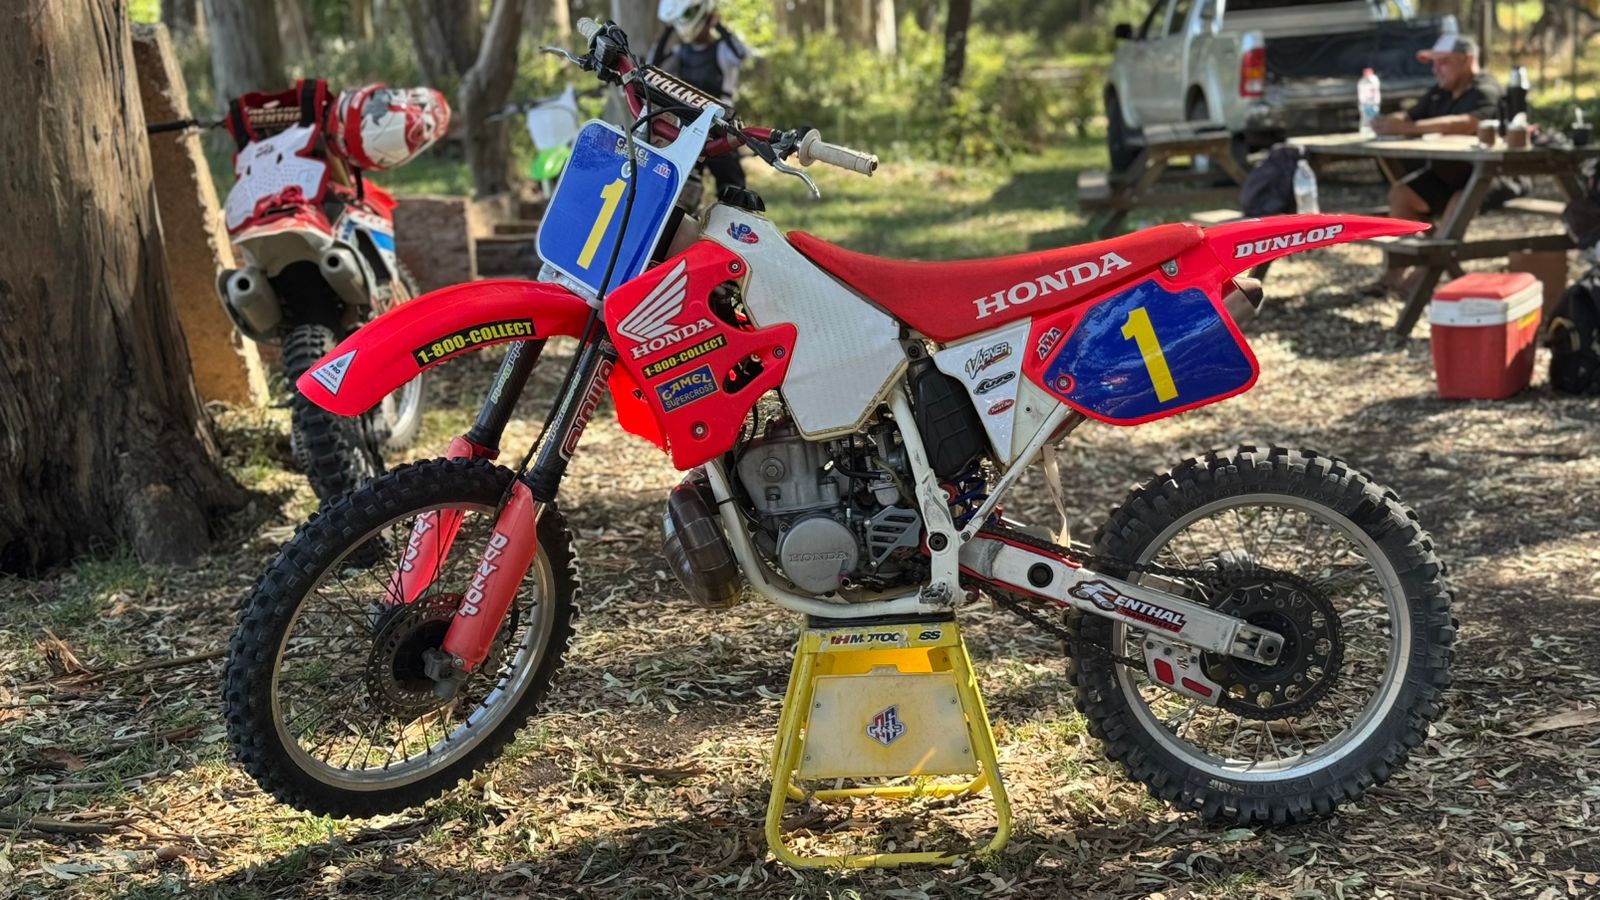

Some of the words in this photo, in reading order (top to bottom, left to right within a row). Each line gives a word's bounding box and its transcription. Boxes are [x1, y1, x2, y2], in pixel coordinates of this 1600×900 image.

[576, 177, 628, 270] 1
[1234, 223, 1344, 259] DUNLOP
[972, 251, 1132, 320] HONDA
[417, 320, 533, 364] 1-800-COLLECT
[629, 317, 715, 360] HONDA
[643, 335, 725, 378] 1-800-COLLECT
[1036, 327, 1061, 360] AMA
[1119, 306, 1179, 403] 1
[661, 372, 712, 400] CAMEL
[665, 383, 715, 409] SUPERCROSS
[457, 531, 510, 617] DUNLOP
[788, 551, 850, 563] HONDA
